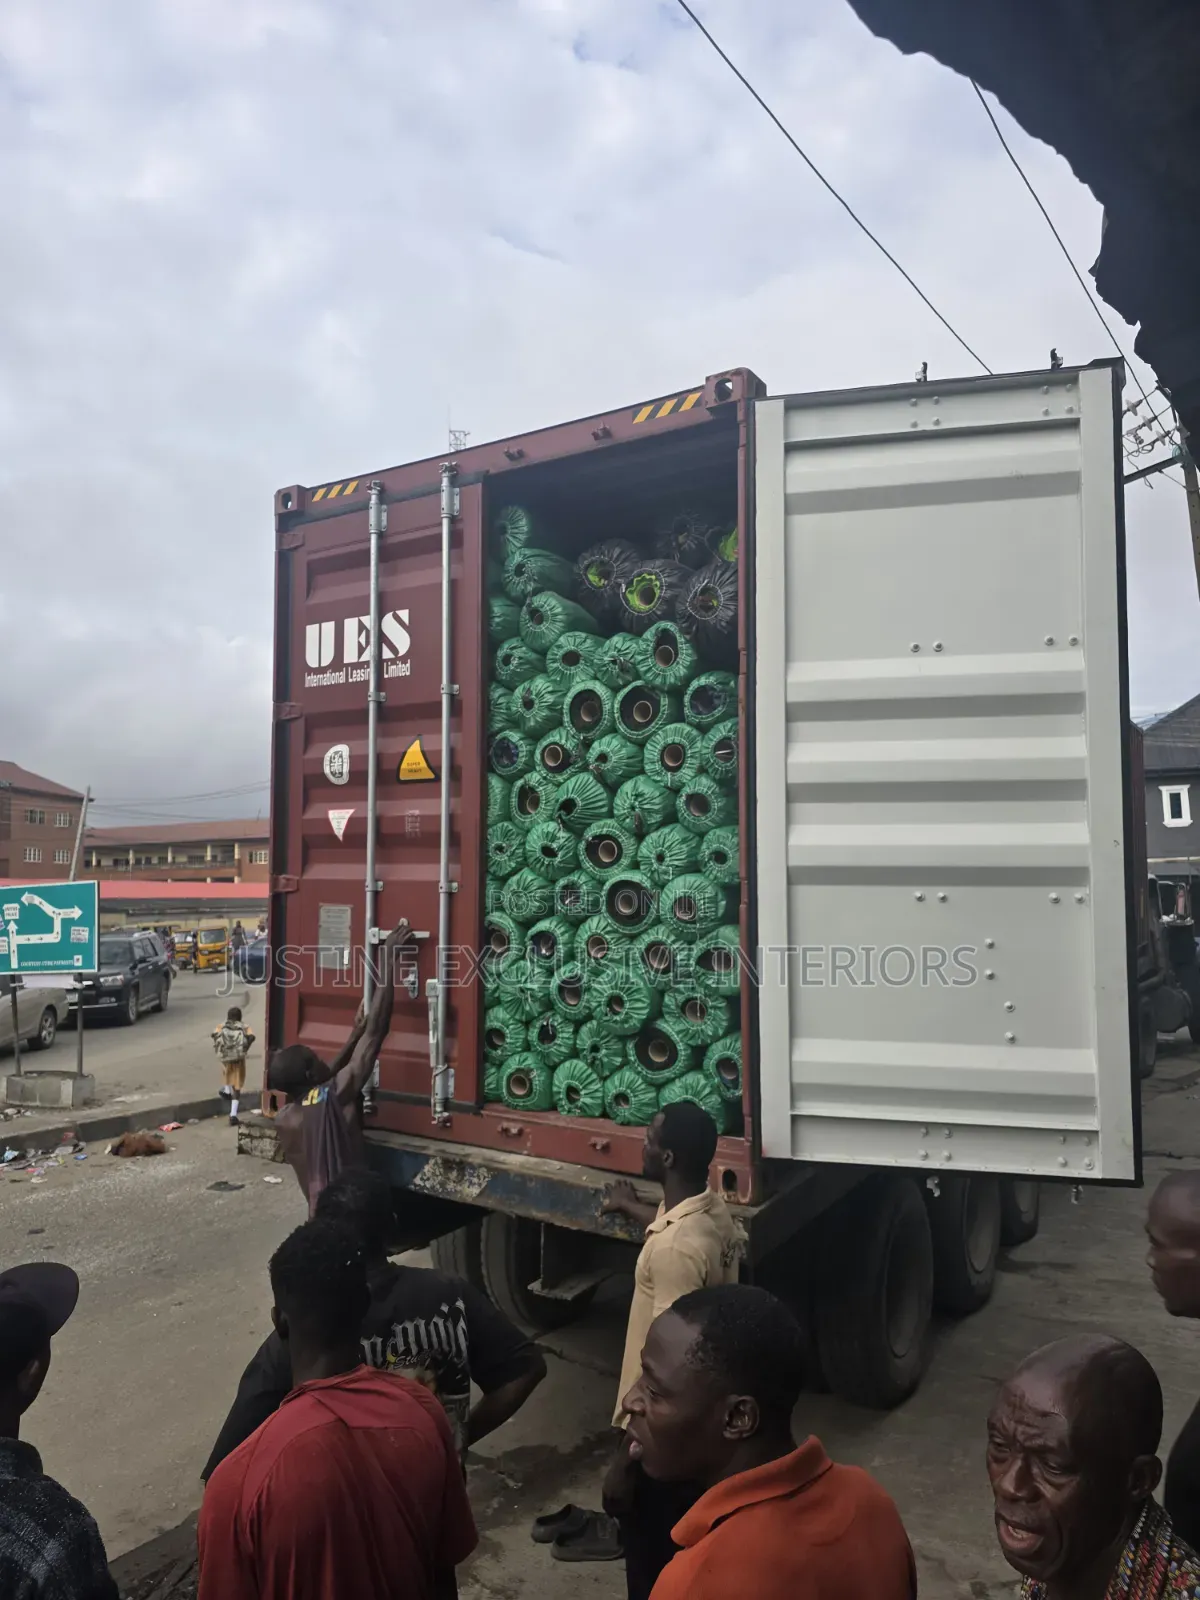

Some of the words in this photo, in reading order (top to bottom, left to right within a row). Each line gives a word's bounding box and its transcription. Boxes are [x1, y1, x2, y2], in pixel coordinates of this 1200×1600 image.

[305, 609, 411, 668] UES
[304, 668, 346, 688] International
[348, 665, 371, 682] Leasin
[383, 659, 411, 678] Limited
